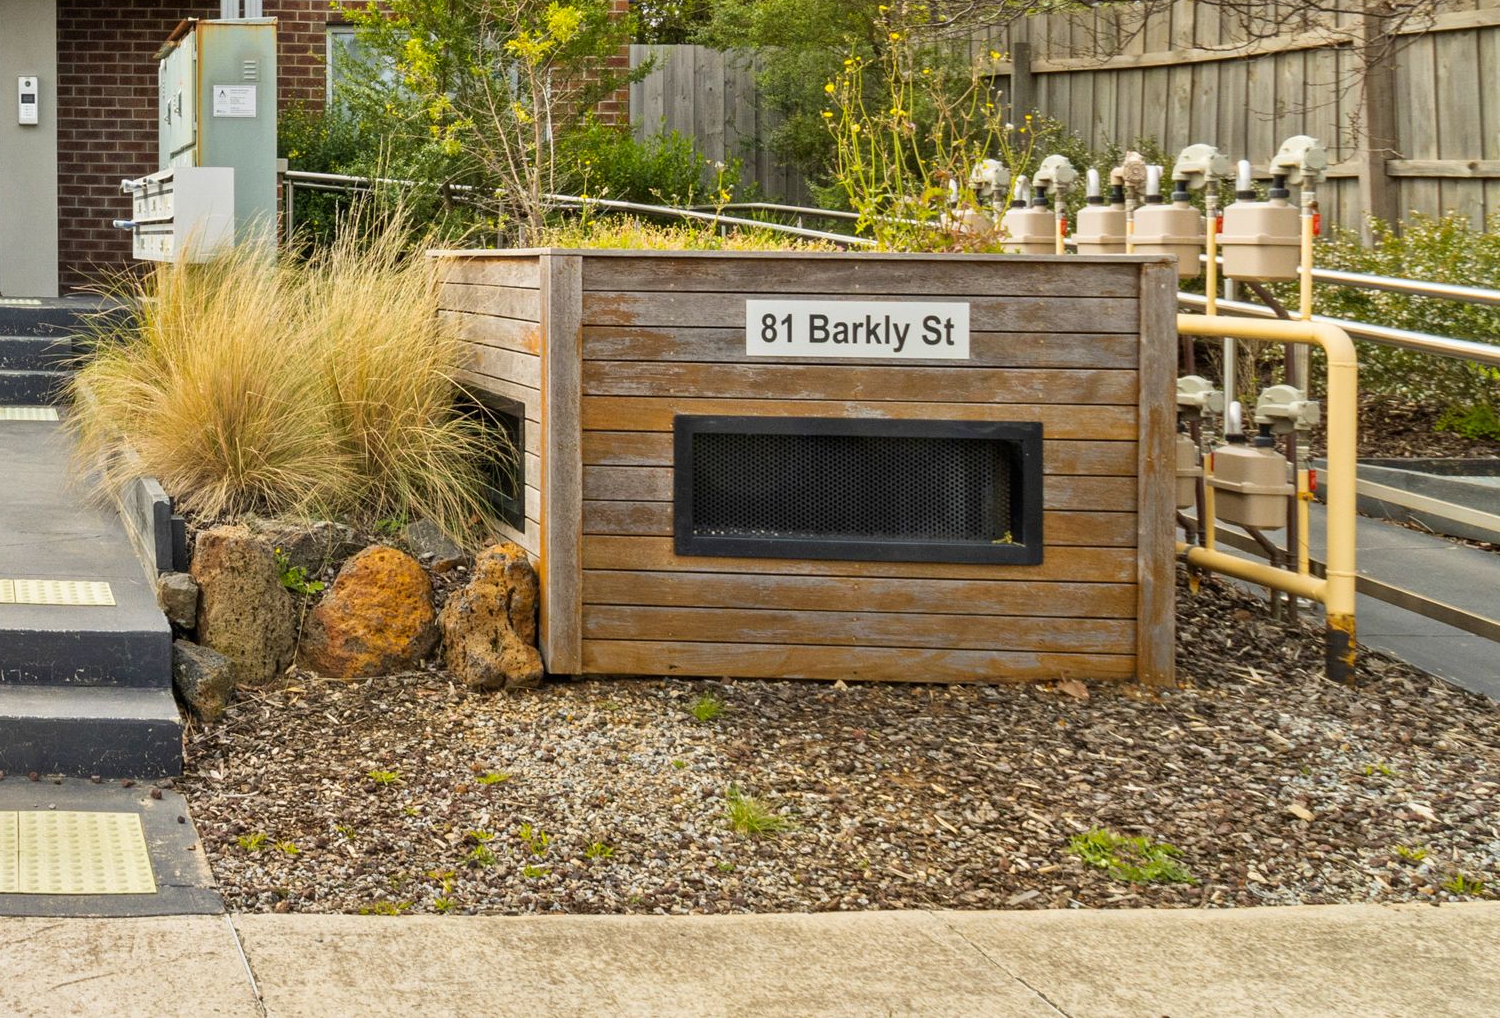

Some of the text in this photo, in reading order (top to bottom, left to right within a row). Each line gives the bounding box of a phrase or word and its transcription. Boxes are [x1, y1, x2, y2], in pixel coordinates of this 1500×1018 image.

[761, 313, 955, 353] 81 Barkly St
